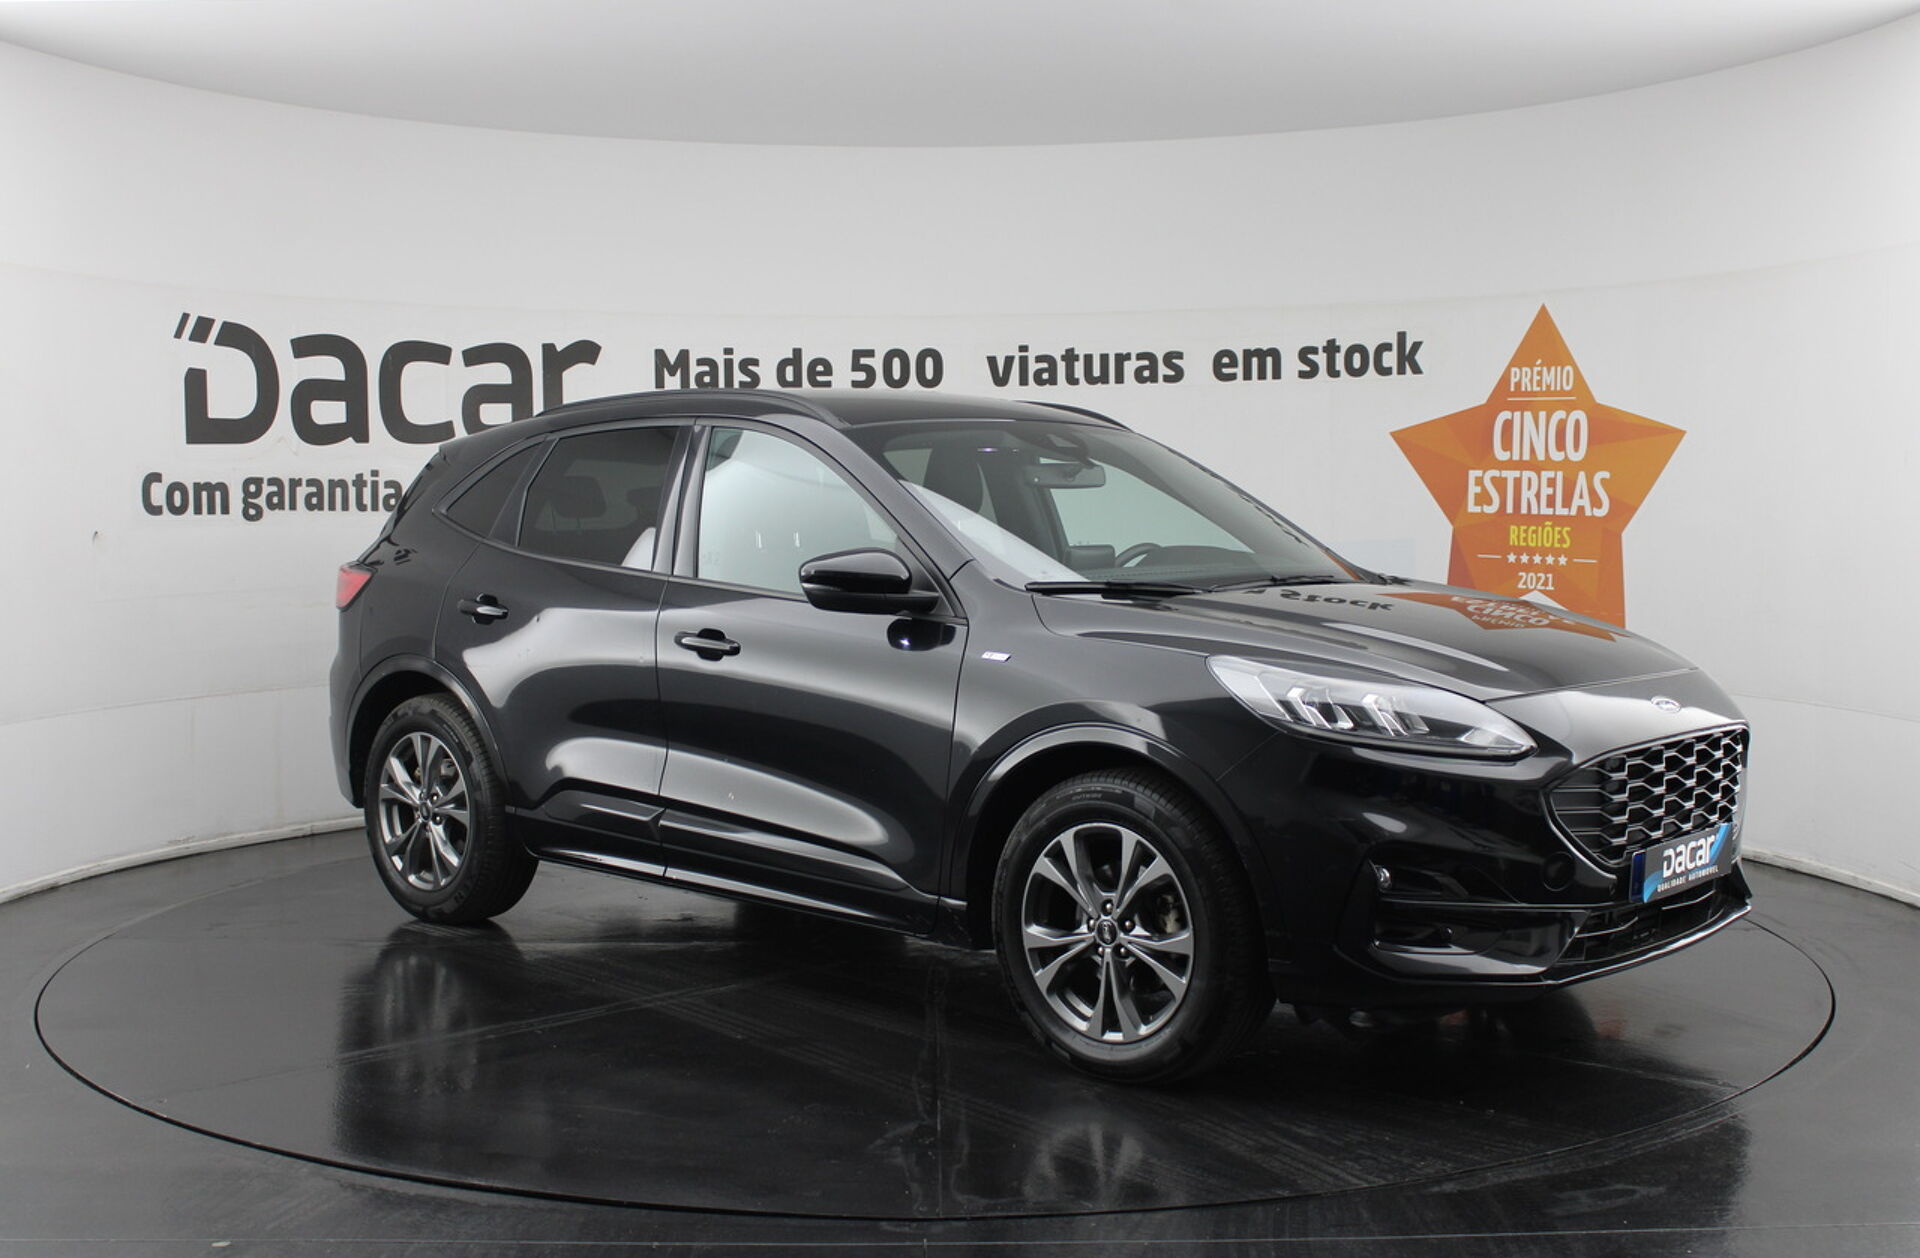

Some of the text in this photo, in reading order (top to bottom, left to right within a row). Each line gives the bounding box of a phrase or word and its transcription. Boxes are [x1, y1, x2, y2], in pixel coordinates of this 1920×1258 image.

[174, 313, 601, 446] Dacar
[654, 331, 1424, 389] Mais de 500 viaturas em stock
[1510, 359, 1574, 392] PRÉMIO
[1493, 410, 1588, 461] CINCO
[141, 469, 403, 521] Com garantia
[1467, 469, 1611, 517] ESTRELAS
[1509, 521, 1571, 548] REGIÕES
[1517, 572, 1555, 590] 2021
